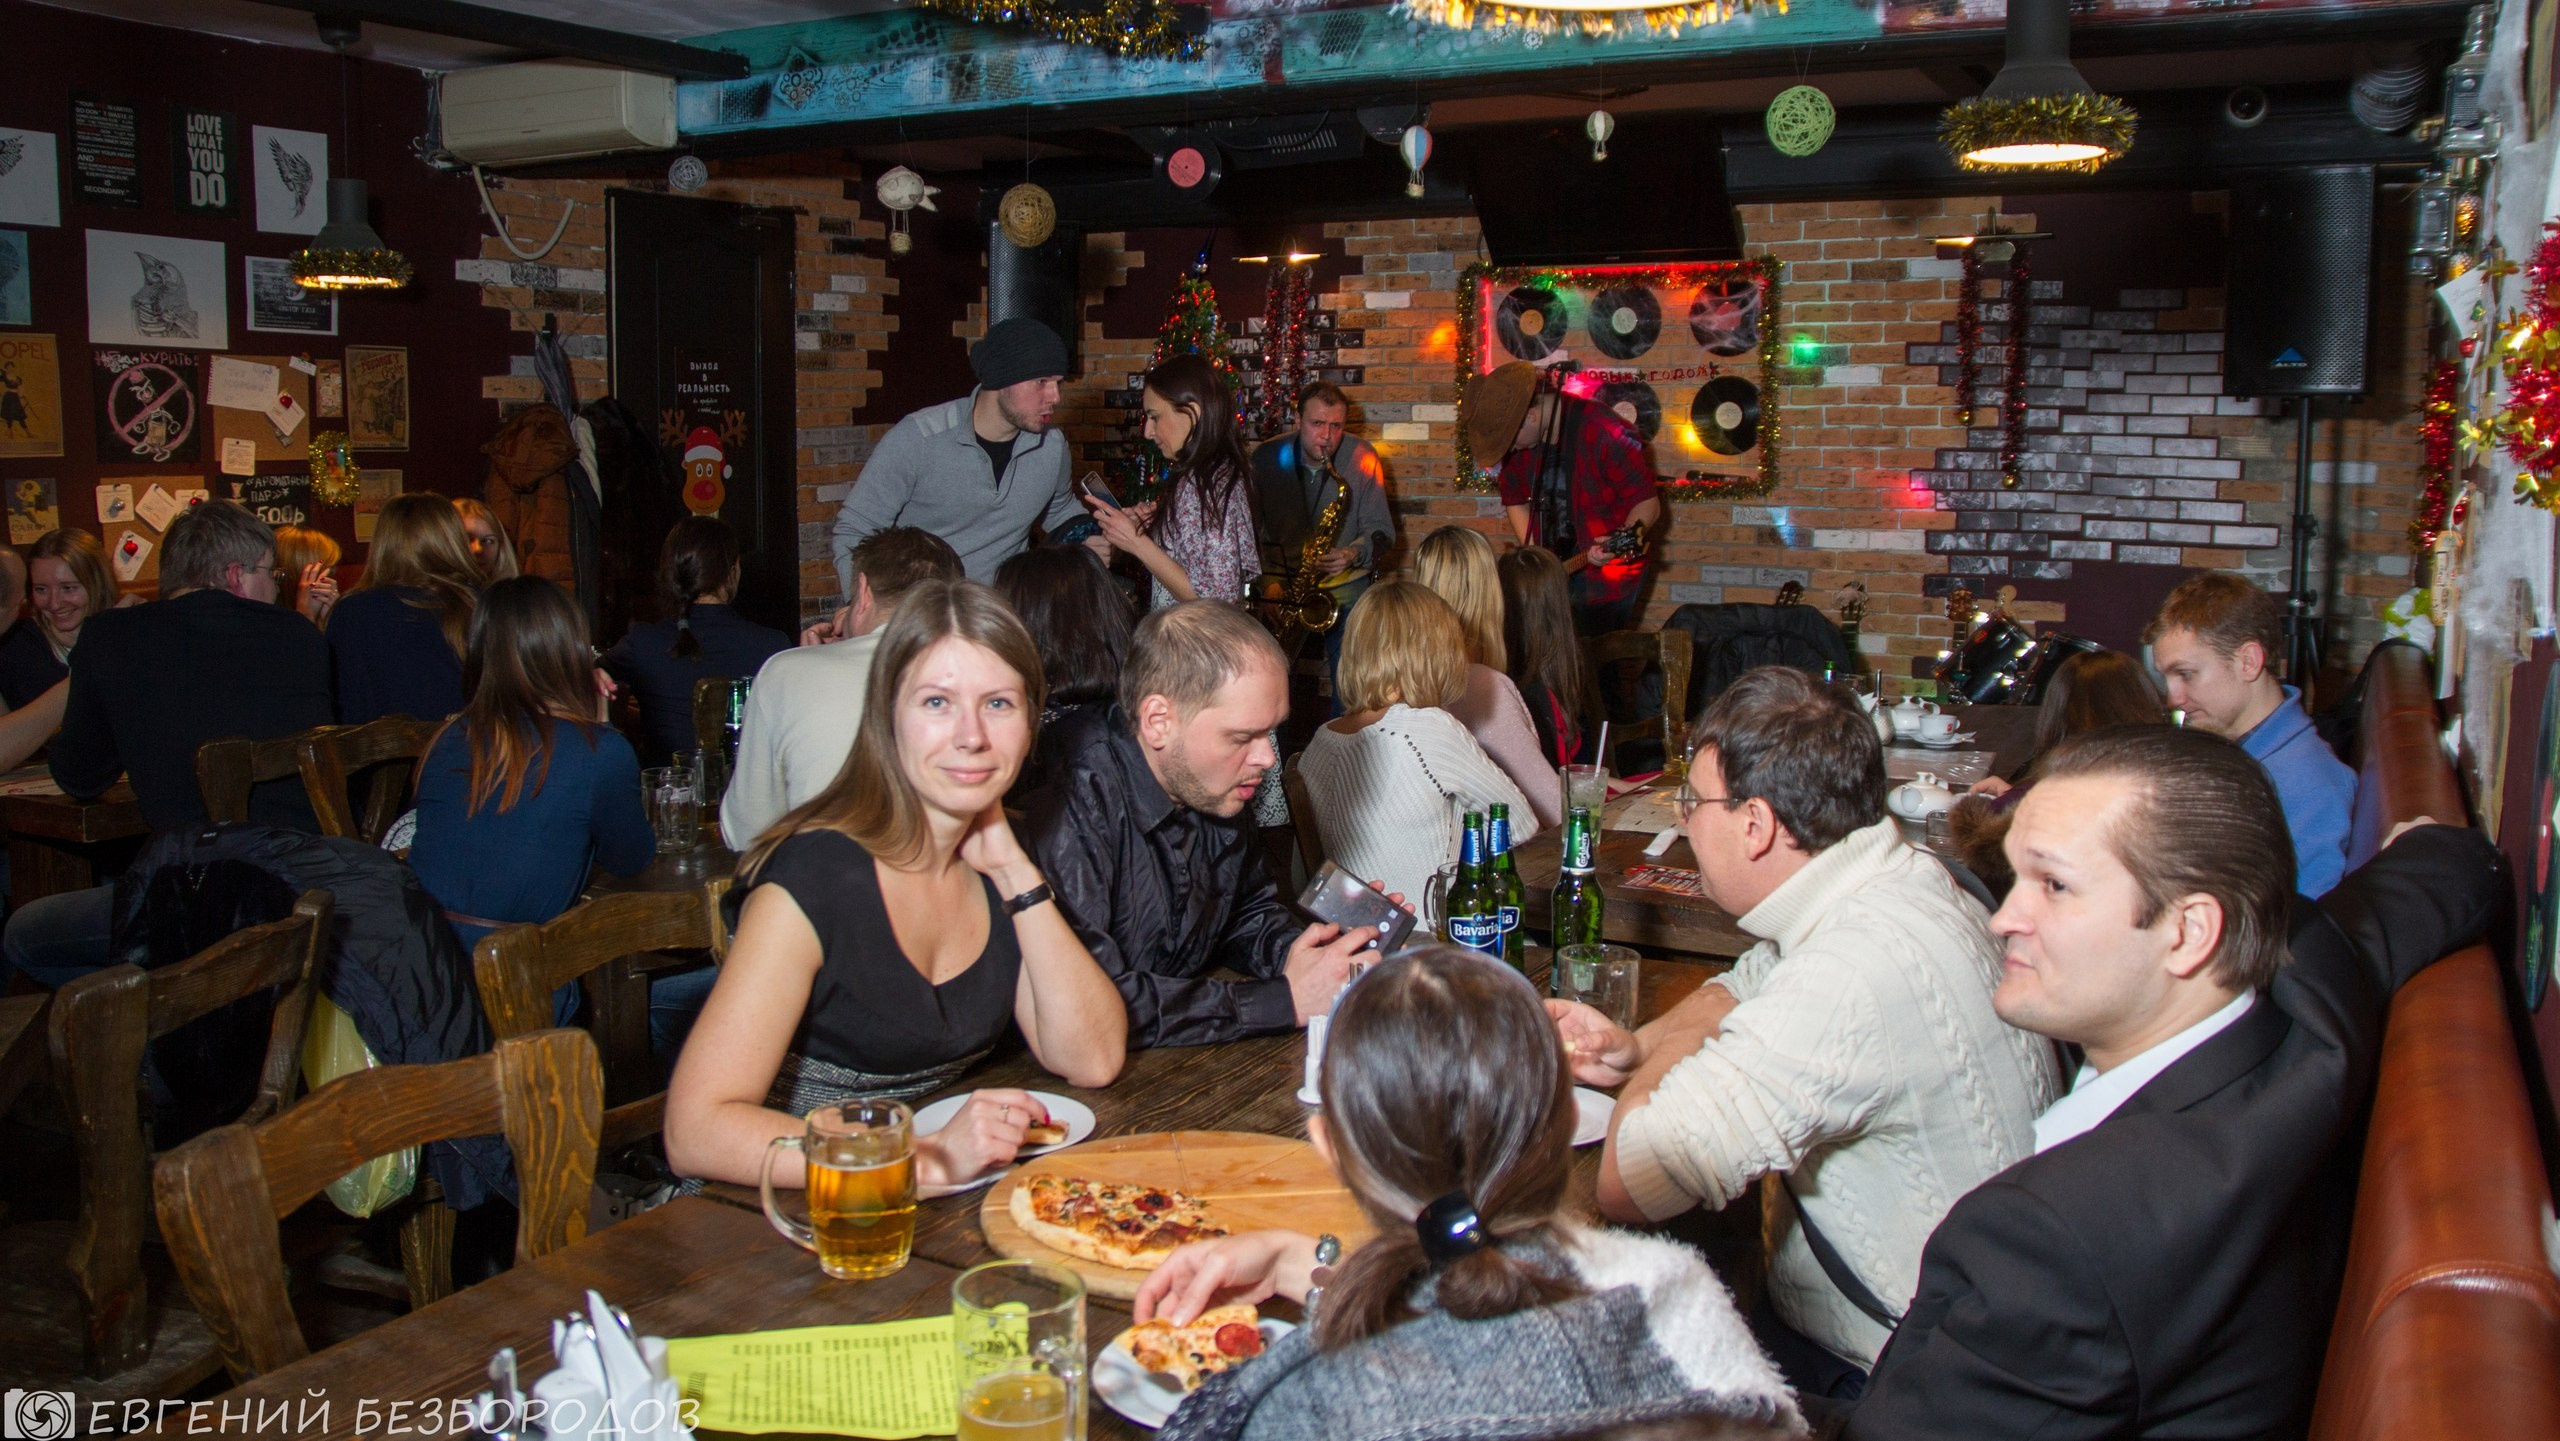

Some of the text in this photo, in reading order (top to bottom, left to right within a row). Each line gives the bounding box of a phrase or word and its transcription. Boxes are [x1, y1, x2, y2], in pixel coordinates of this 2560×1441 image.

[187, 113, 222, 136] LOVE
[187, 132, 223, 151] WHAT
[187, 147, 224, 174] YOU
[190, 171, 226, 207] DO
[0, 341, 50, 361] OPEL
[690, 361, 718, 371] ВЫХОД
[702, 372, 708, 382] В
[678, 383, 730, 394] РЕАЛЬНОСТЬ
[1472, 830, 1481, 864] Bavaria
[1455, 920, 1499, 937] Bavaria
